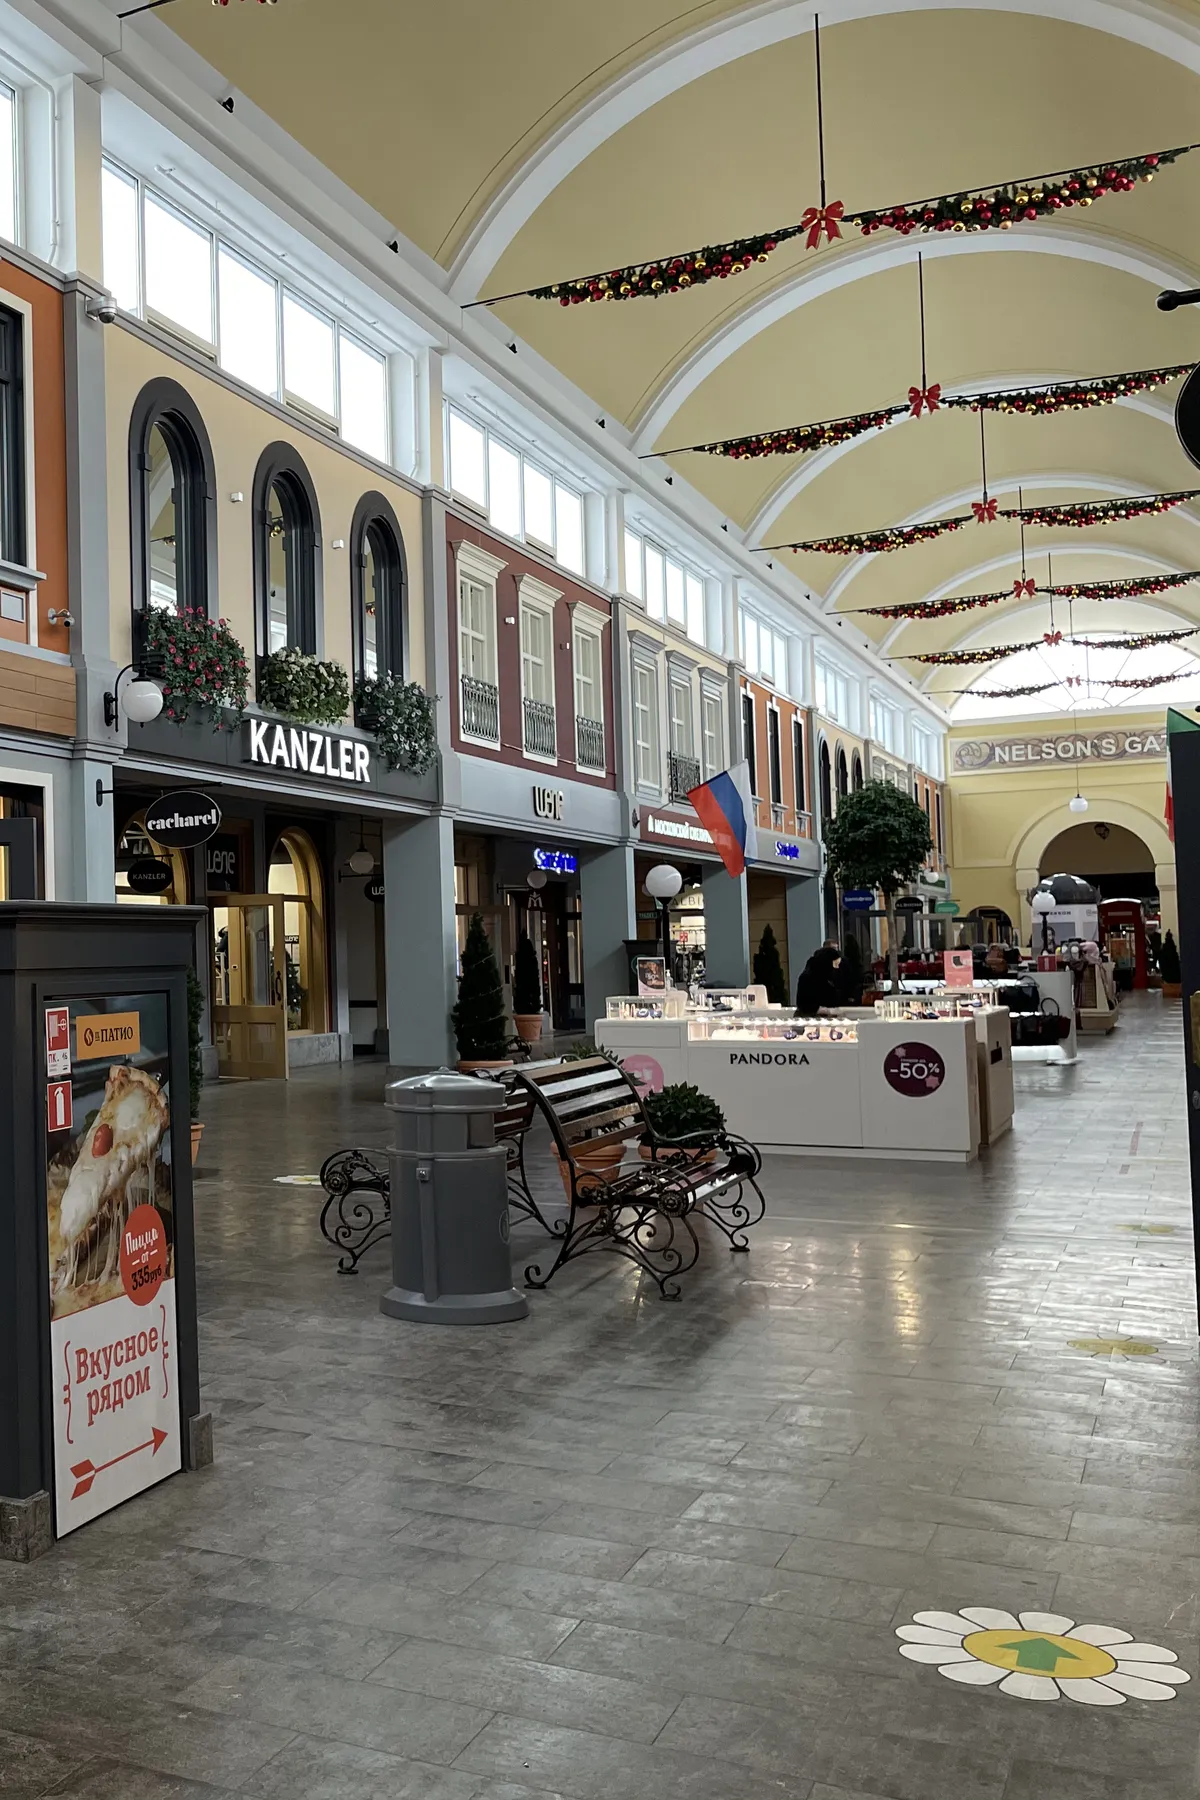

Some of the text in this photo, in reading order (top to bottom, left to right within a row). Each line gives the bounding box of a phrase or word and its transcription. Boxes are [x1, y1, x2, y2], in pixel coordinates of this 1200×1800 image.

[250, 719, 370, 783] KANZLER
[995, 738, 1116, 763] NELSON'S
[147, 809, 217, 830] cacharel
[132, 872, 166, 880] KANZLER
[671, 896, 701, 906] ALBI
[100, 1026, 134, 1043] ПАТИО
[730, 1053, 810, 1066] PANDORA
[890, 1062, 940, 1080] -50%
[125, 1228, 159, 1256] Пицца
[75, 1326, 158, 1385] Вкусное
[87, 1365, 151, 1427] рядом
